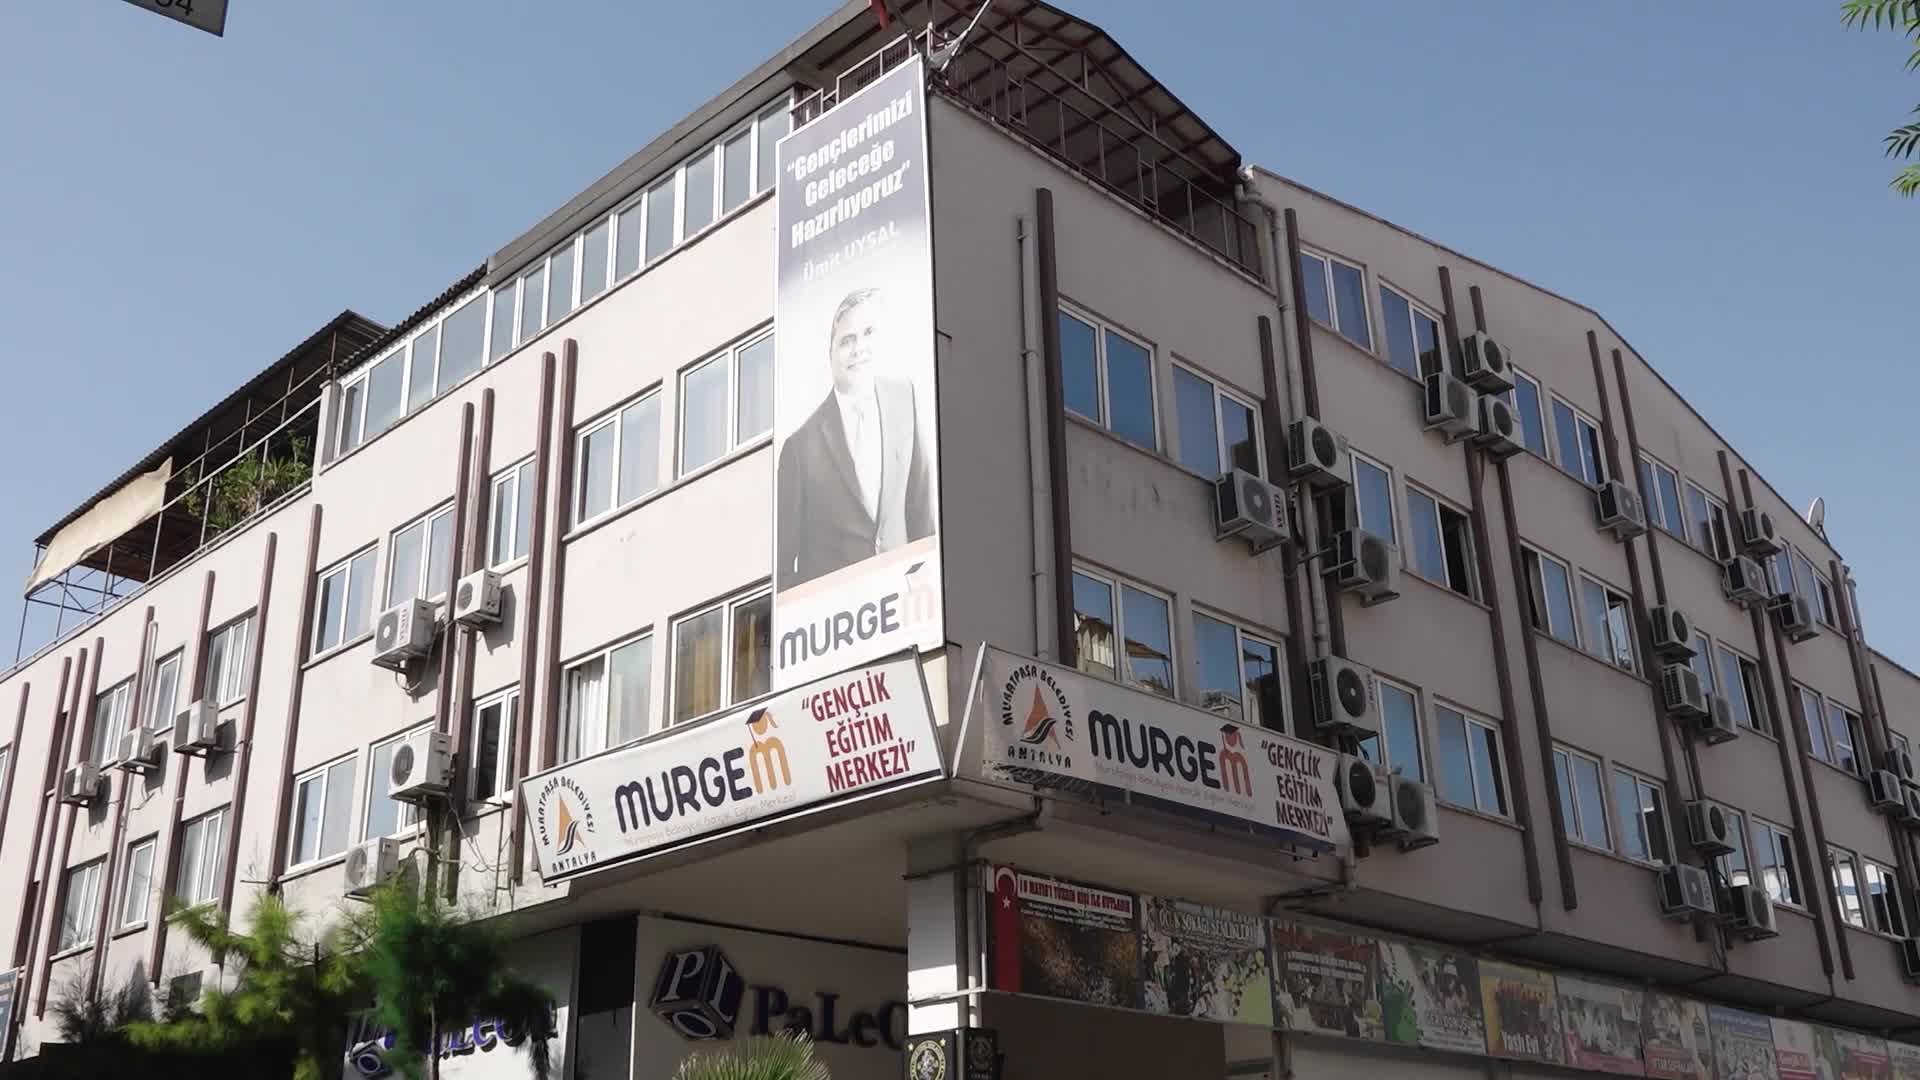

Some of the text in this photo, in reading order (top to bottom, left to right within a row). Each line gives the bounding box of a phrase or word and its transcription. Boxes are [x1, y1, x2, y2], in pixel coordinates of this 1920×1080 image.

[786, 89, 913, 181] "Gençlerimizi
[804, 139, 895, 208] Geleceğe
[843, 220, 897, 259] UYSAL
[802, 670, 892, 722] "GENÇLİK
[825, 711, 894, 758] EĞİTİM
[1007, 745, 1072, 769] ANTALYA
[825, 736, 916, 793] MERKEZİ"
[1276, 772, 1323, 809] EĞİTİM
[552, 850, 597, 873] ANTALYA
